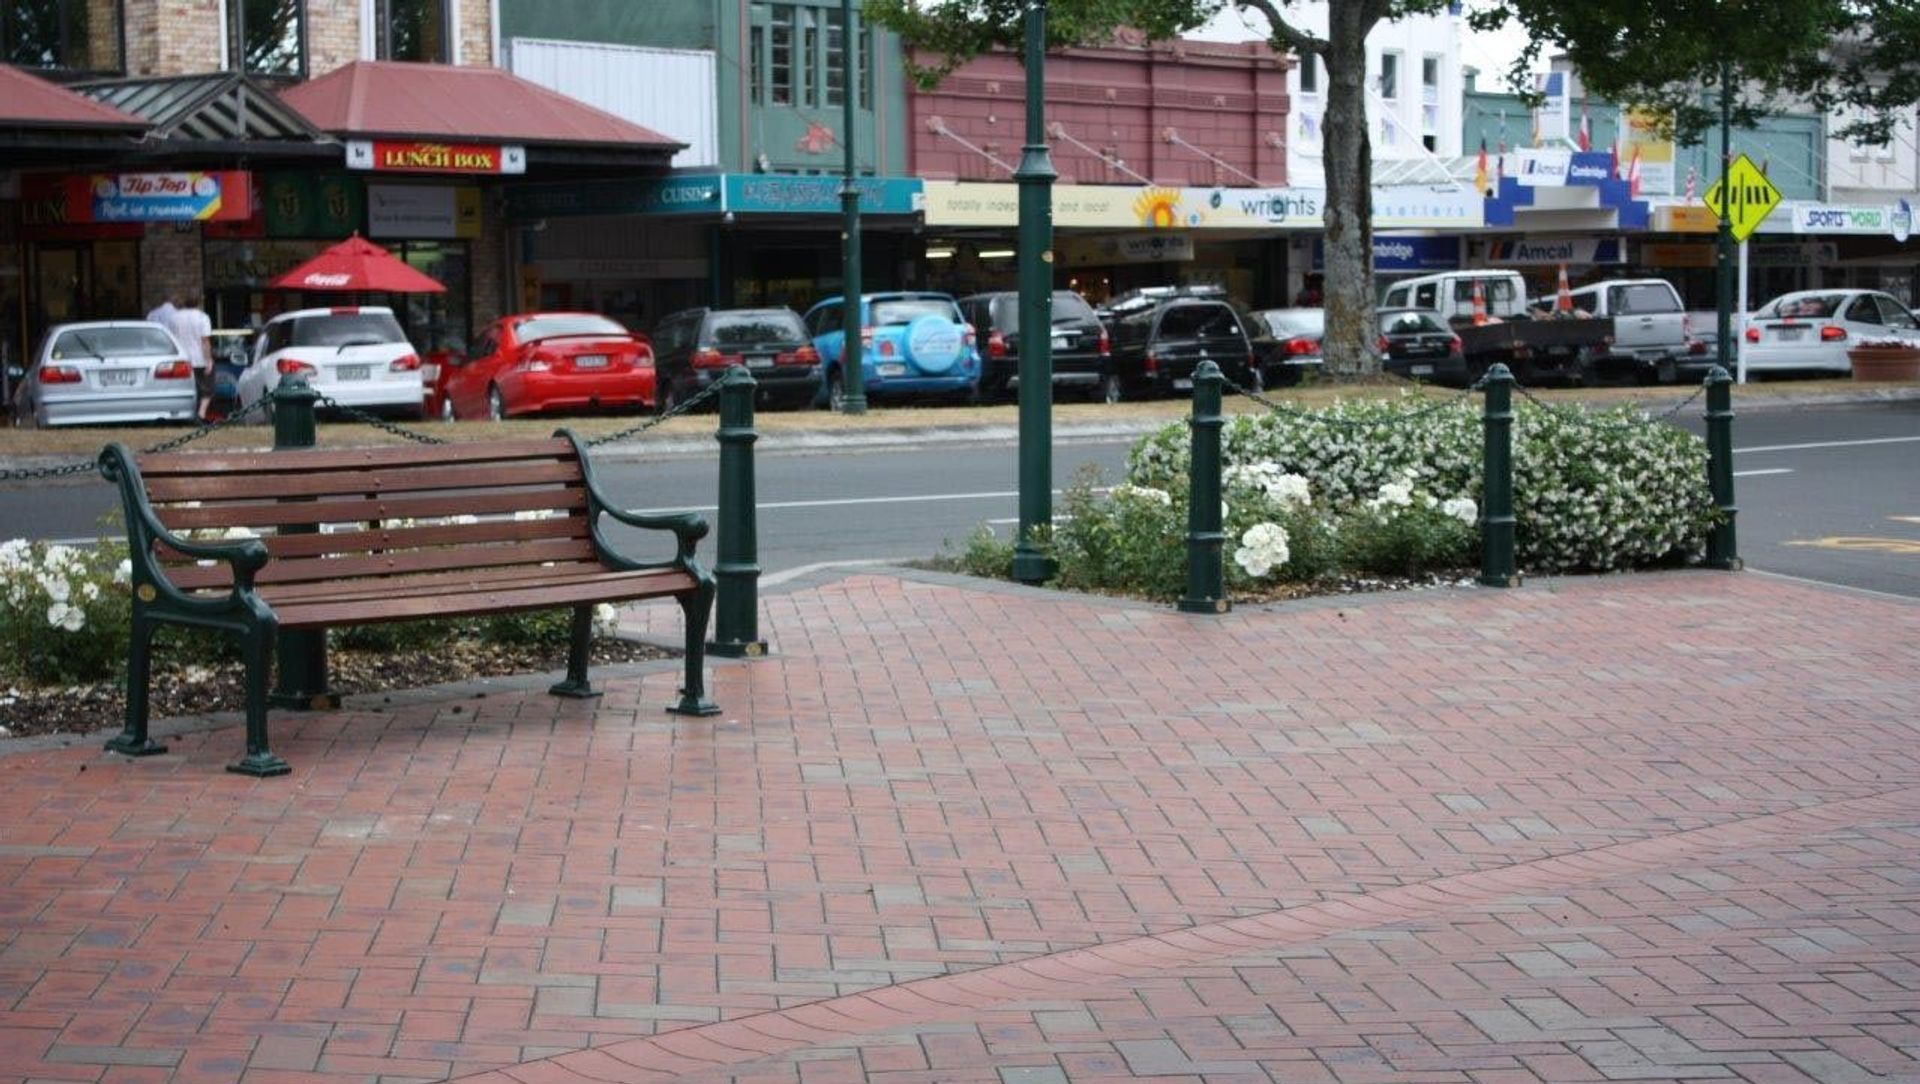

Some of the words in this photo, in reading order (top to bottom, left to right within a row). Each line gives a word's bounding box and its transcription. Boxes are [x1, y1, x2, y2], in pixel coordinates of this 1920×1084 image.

[386, 150, 450, 168] LUNCH
[454, 153, 494, 169] BOX
[1536, 160, 1565, 176] Amcal
[123, 177, 153, 194] Tip
[155, 176, 188, 194] Top
[946, 199, 981, 213] totally
[1240, 194, 1317, 223] wrights
[1386, 204, 1466, 218] sellers
[1806, 210, 1846, 227] SPORTS
[1850, 210, 1882, 227] WORLD
[1373, 241, 1414, 260] mbridge
[1516, 242, 1574, 260] Amcal
